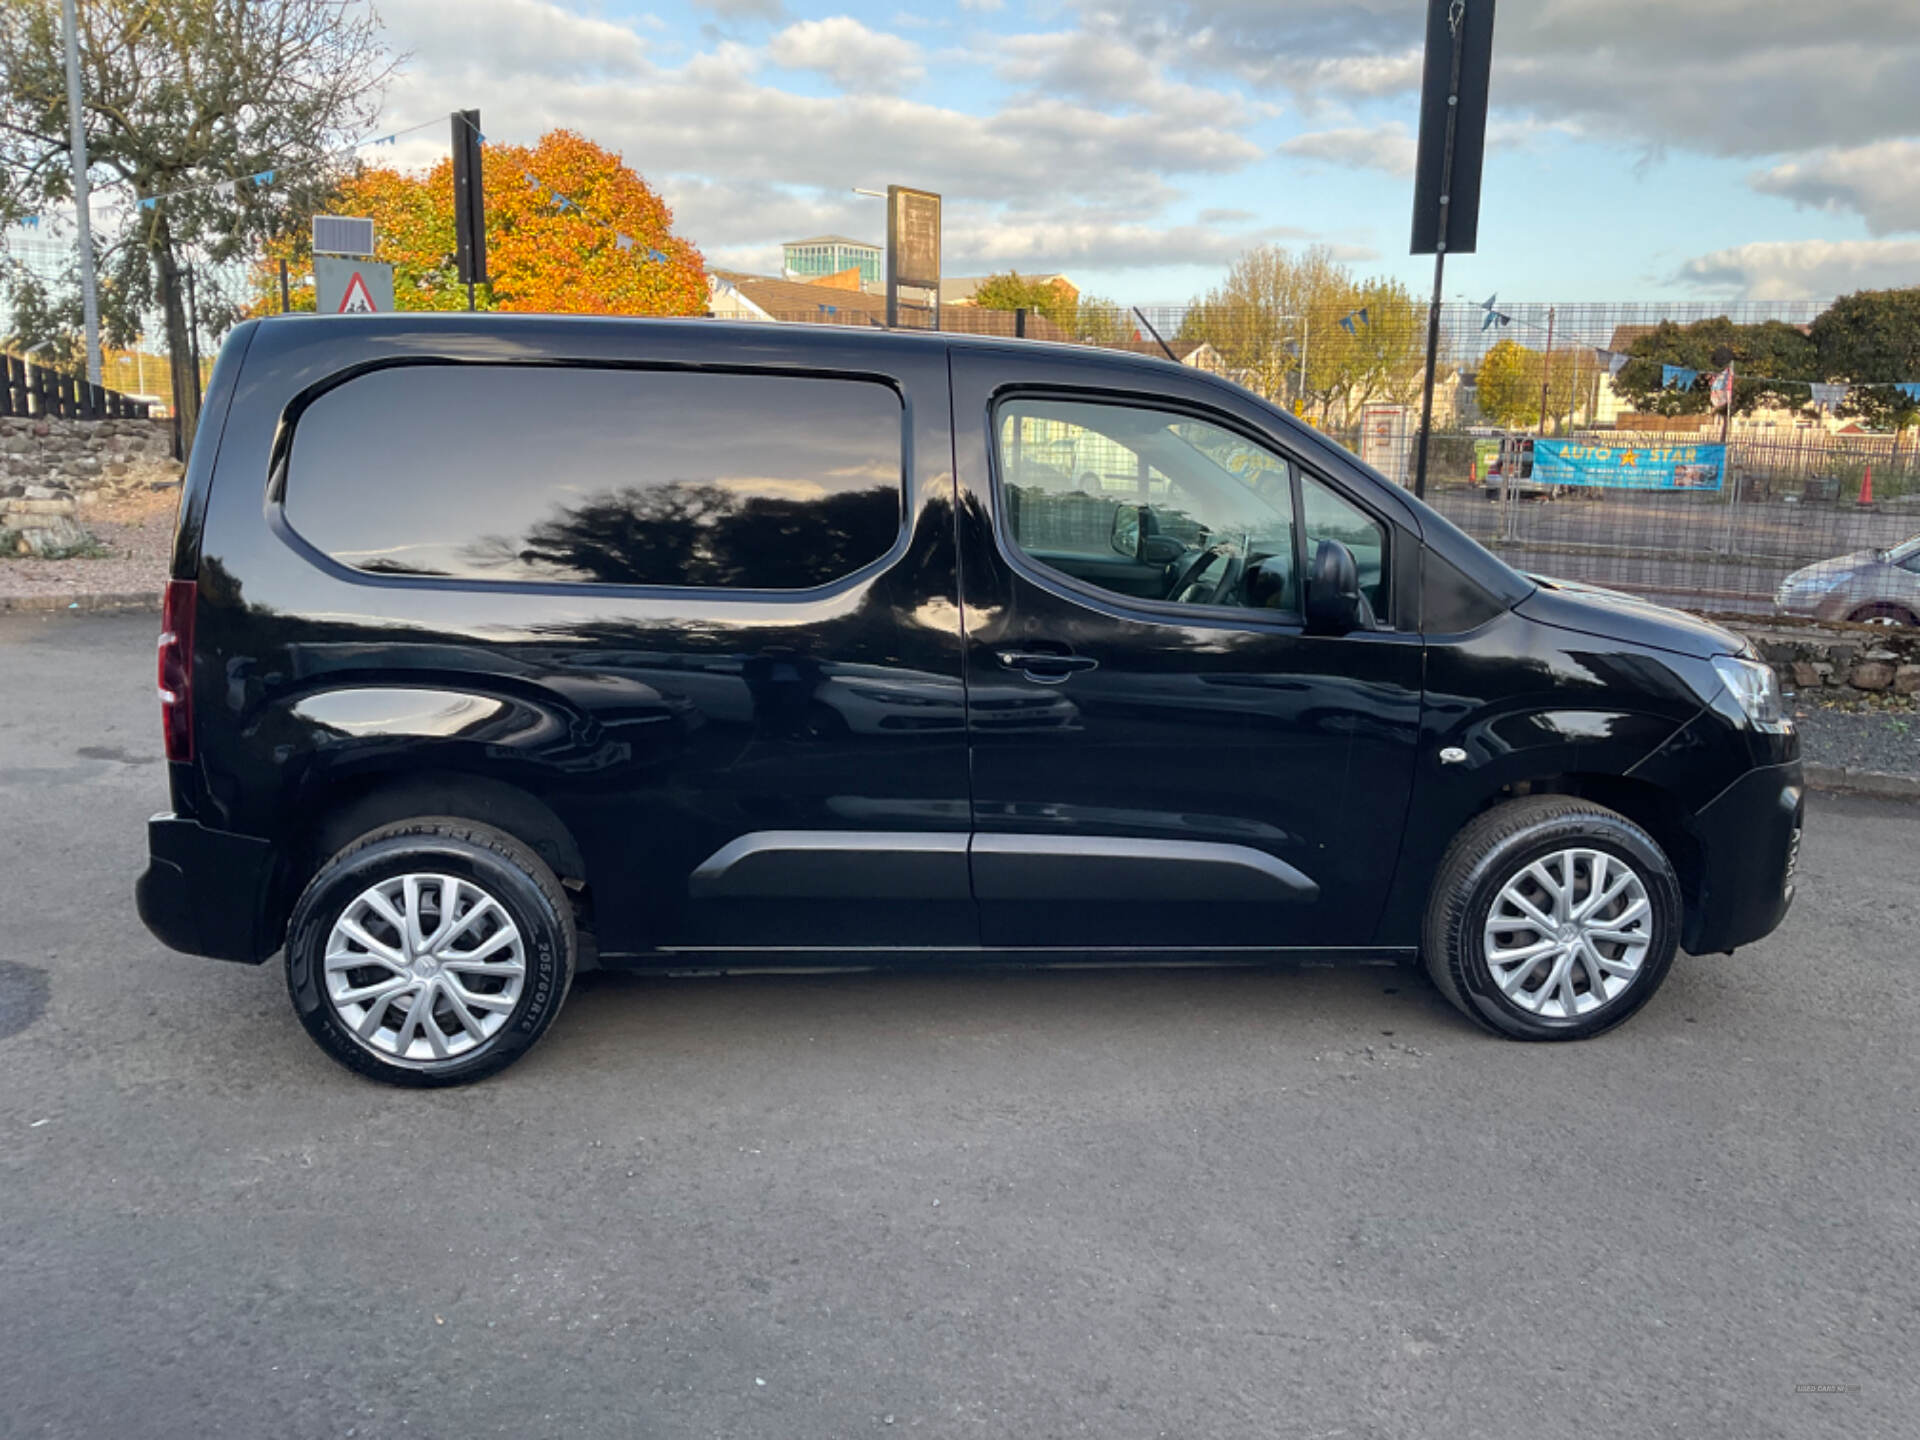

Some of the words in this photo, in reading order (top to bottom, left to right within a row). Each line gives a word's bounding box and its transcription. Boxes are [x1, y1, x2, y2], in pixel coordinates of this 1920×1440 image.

[1559, 445, 1611, 461] AUTO
[1650, 448, 1697, 463] STAR
[522, 942, 552, 1031] 205/60R16
